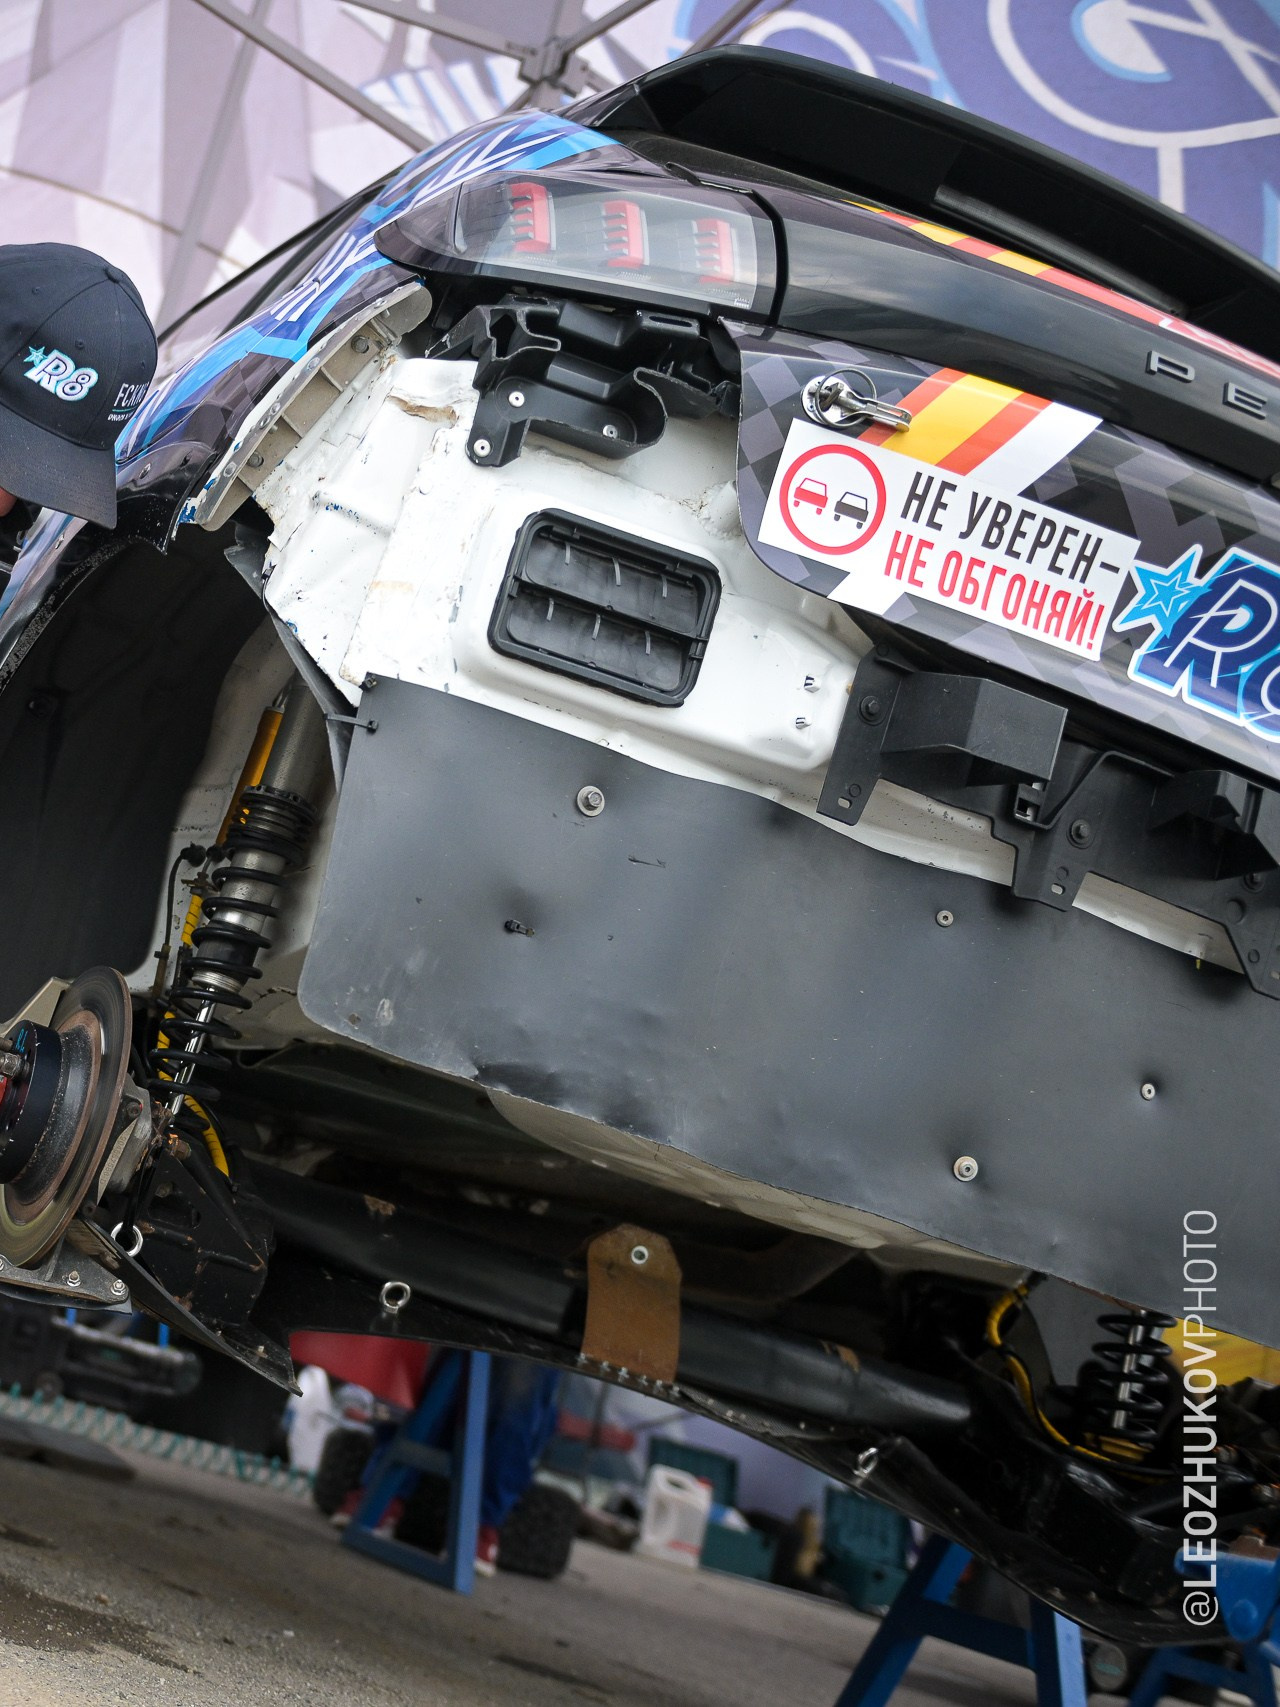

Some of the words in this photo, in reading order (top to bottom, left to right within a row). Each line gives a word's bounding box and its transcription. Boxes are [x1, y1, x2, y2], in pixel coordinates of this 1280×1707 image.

[23, 349, 99, 401] R8
[900, 471, 958, 532] НЕ
[884, 529, 935, 588] НЕ
[937, 550, 1105, 651] ОБГОНЯЙ!
